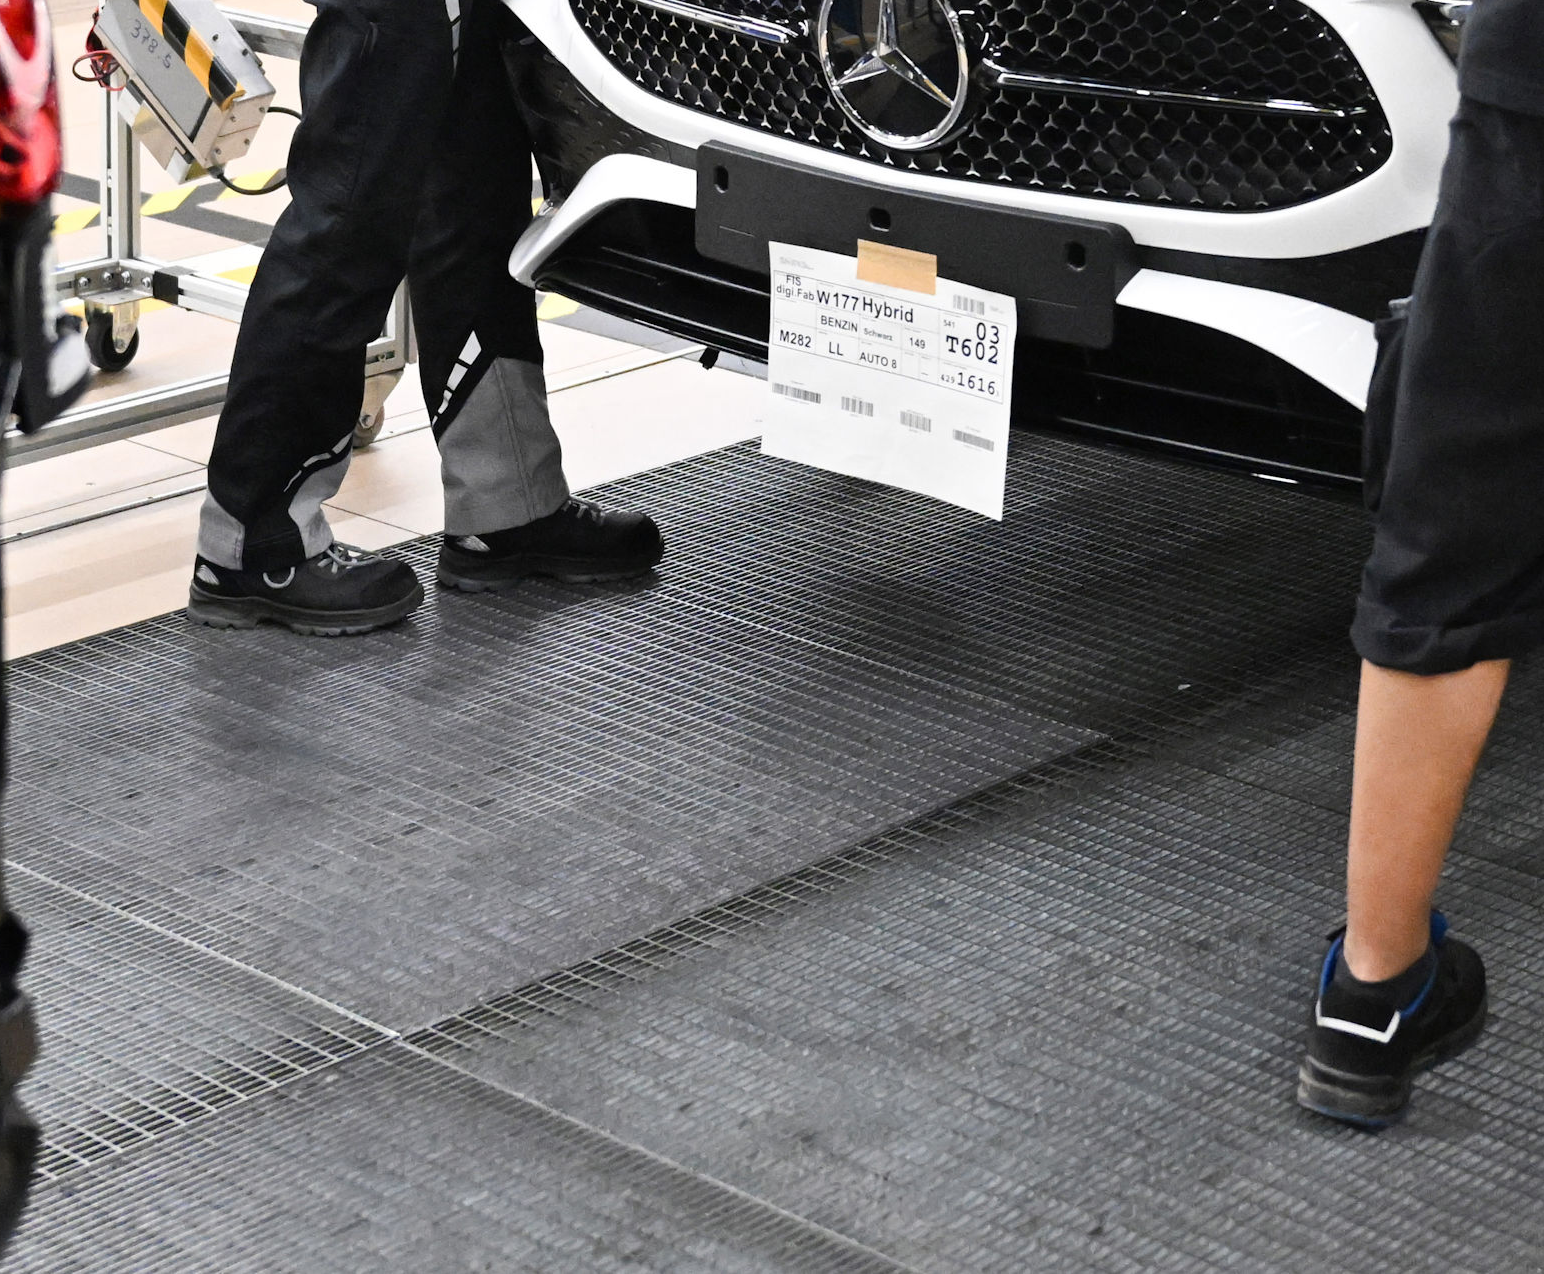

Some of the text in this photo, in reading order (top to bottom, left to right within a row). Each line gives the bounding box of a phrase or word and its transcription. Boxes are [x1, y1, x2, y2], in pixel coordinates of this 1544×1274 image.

[786, 274, 802, 286] FIS
[776, 284, 815, 301] digi.Fab
[816, 289, 914, 323] W177 Hybrid
[820, 315, 858, 332] BENZIN
[779, 329, 812, 348] M282
[863, 328, 893, 342] Schwarz
[976, 322, 1000, 345] 03
[828, 341, 844, 356] LL
[909, 337, 926, 349] 149
[946, 335, 999, 365] T602
[859, 351, 897, 369] AUTO 8
[957, 371, 996, 395] 1616
